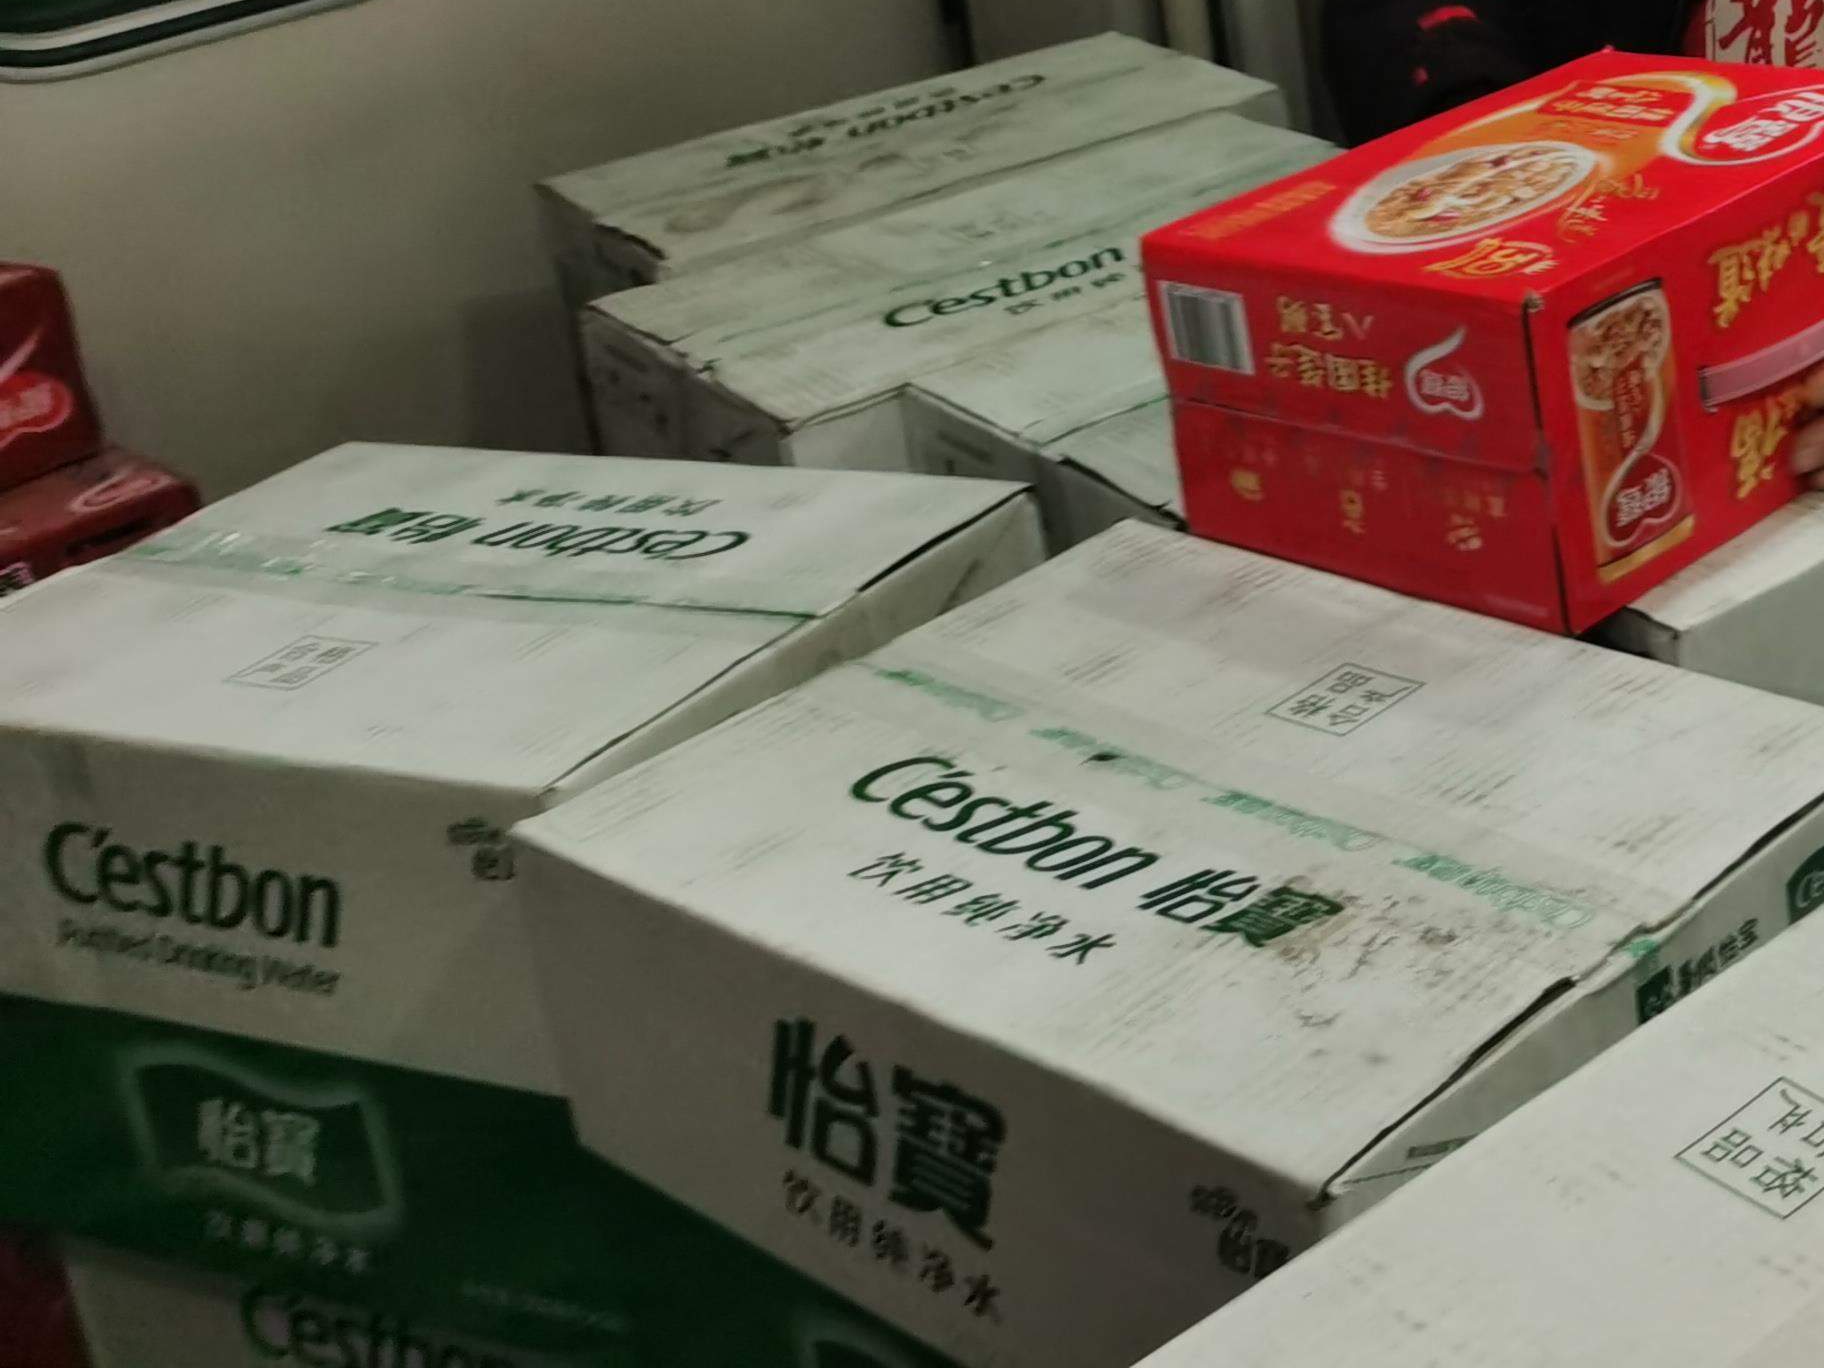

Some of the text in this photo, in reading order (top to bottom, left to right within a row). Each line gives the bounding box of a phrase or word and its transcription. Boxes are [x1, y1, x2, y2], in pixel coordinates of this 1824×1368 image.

[849, 849, 1118, 965] 饮用纯净水
[767, 1018, 1006, 1251] 怡寶
